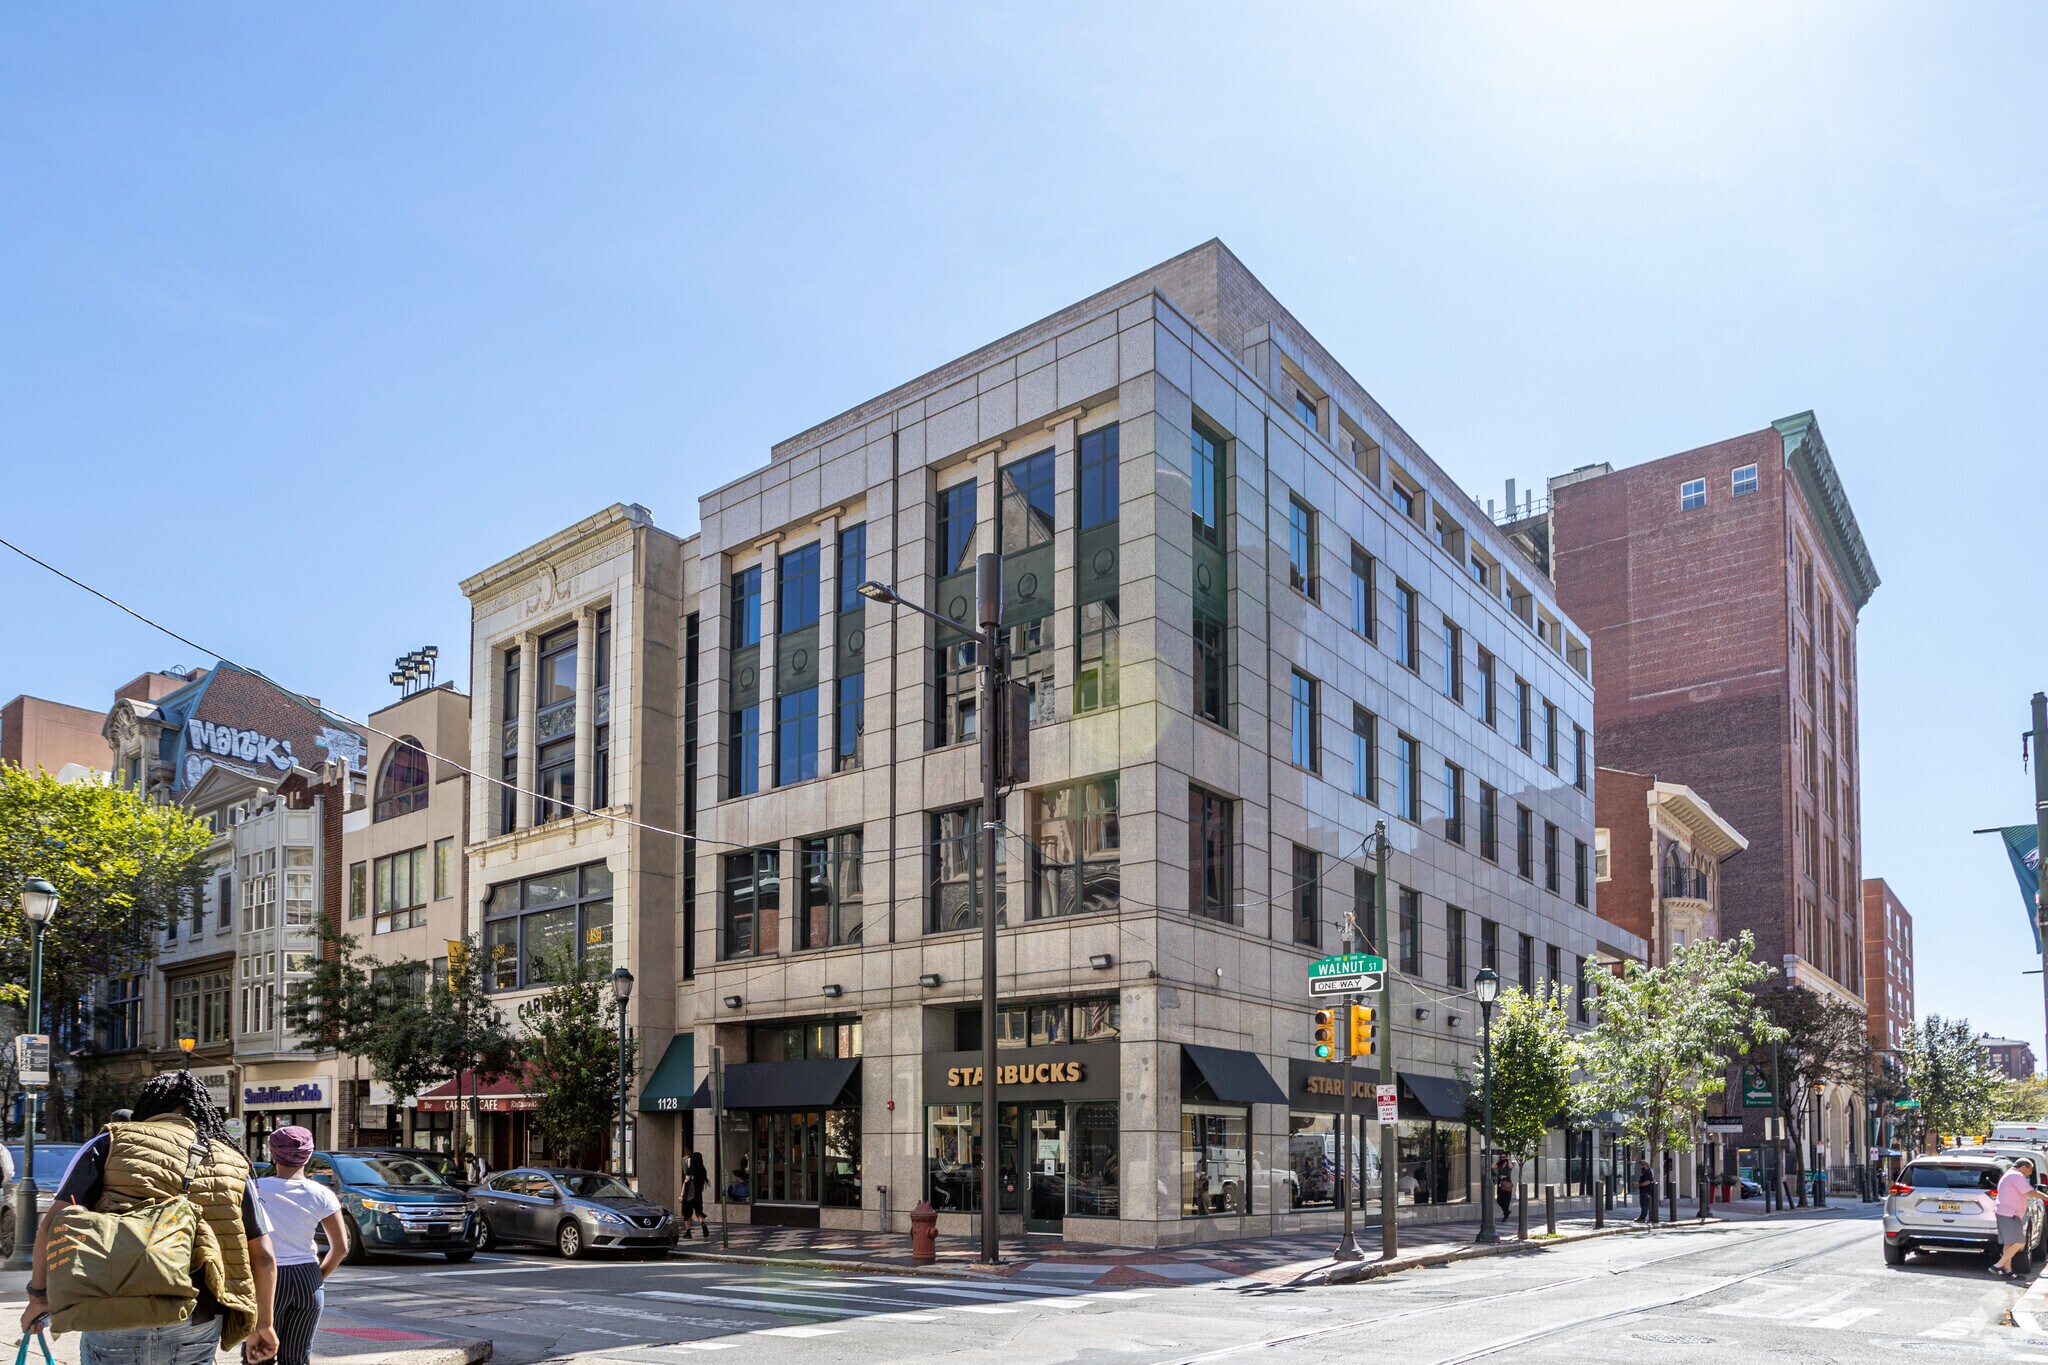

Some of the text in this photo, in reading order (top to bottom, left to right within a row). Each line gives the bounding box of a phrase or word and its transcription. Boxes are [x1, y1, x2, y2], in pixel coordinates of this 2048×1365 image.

[1318, 960, 1377, 976] WALNUT ST
[1318, 979, 1360, 990] ONE WAY
[244, 1083, 323, 1104] SmileDirectClub
[1307, 1075, 1377, 1099] STARUCKS
[444, 1100, 470, 1111] CARBO
[657, 1097, 678, 1110] 1128
